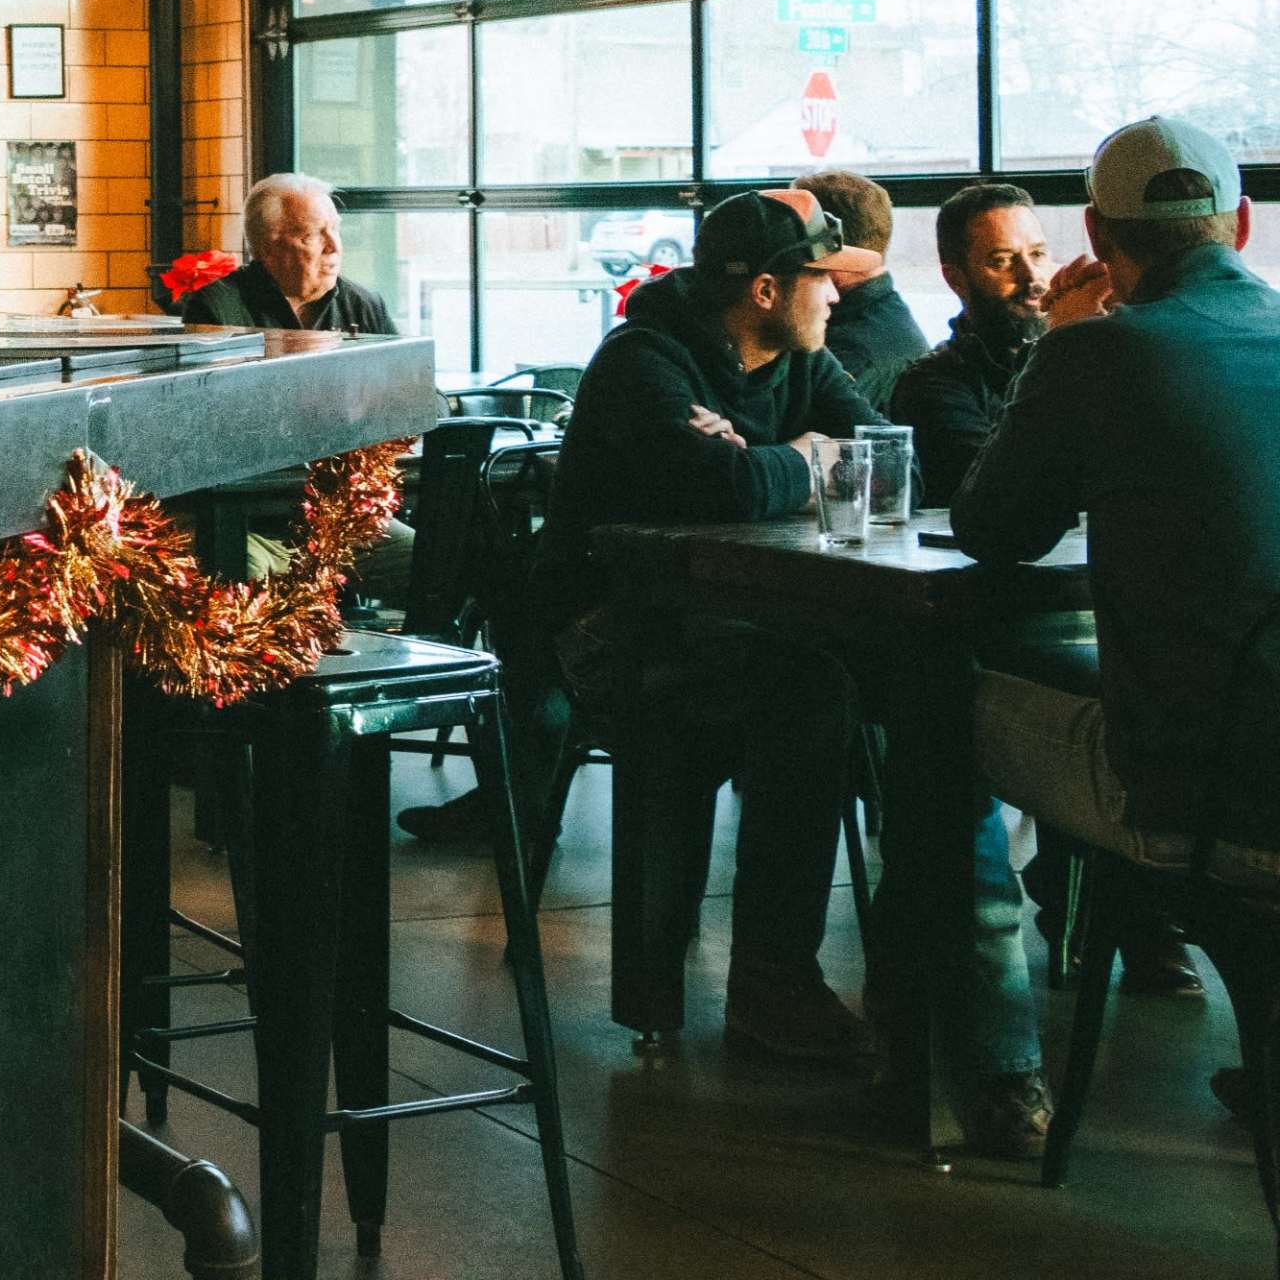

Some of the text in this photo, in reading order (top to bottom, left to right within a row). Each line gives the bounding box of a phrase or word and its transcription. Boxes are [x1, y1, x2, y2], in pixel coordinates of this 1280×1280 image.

[801, 100, 837, 131] STOP
[16, 163, 54, 174] Small
[12, 173, 51, 184] Batch
[27, 184, 69, 195] Trivia
